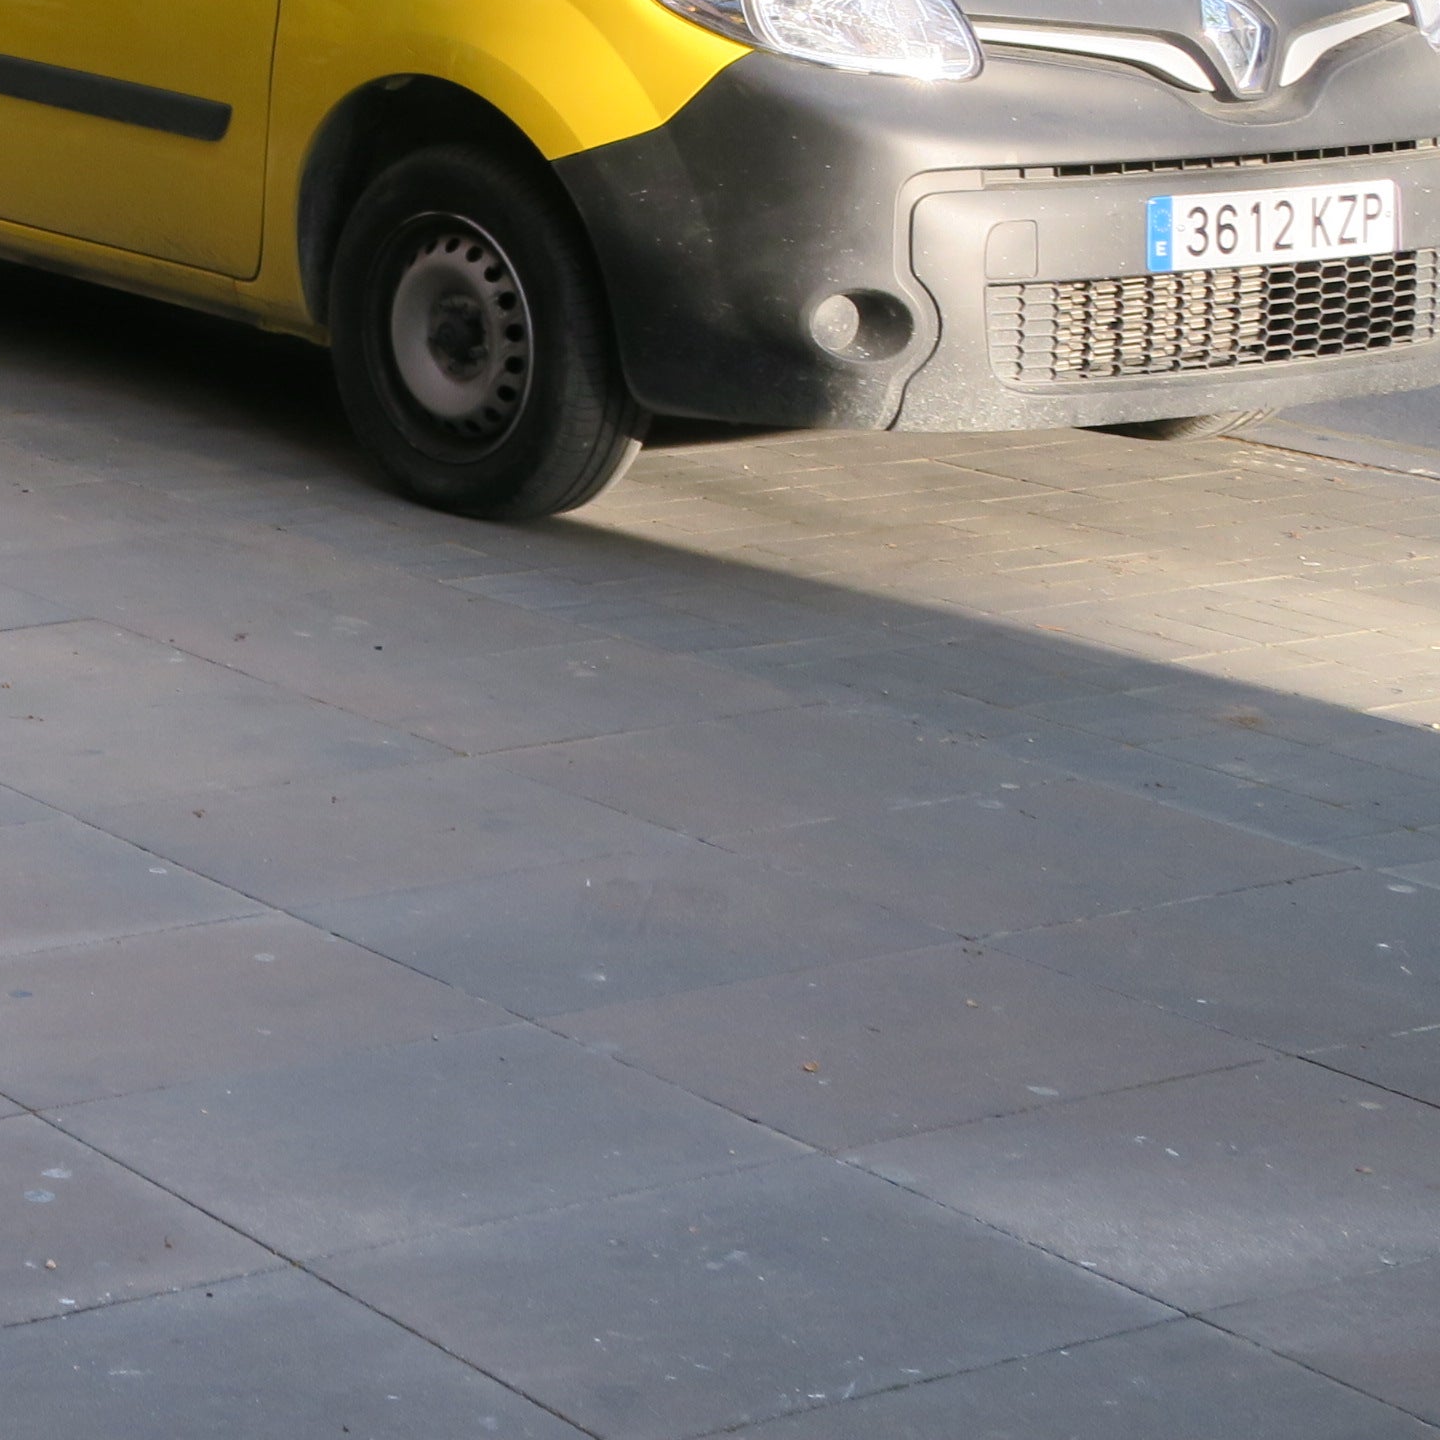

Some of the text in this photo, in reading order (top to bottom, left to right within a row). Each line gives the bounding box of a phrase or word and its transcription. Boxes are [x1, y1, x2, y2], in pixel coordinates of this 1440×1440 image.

[1155, 192, 1383, 257] E 3612 KZP
